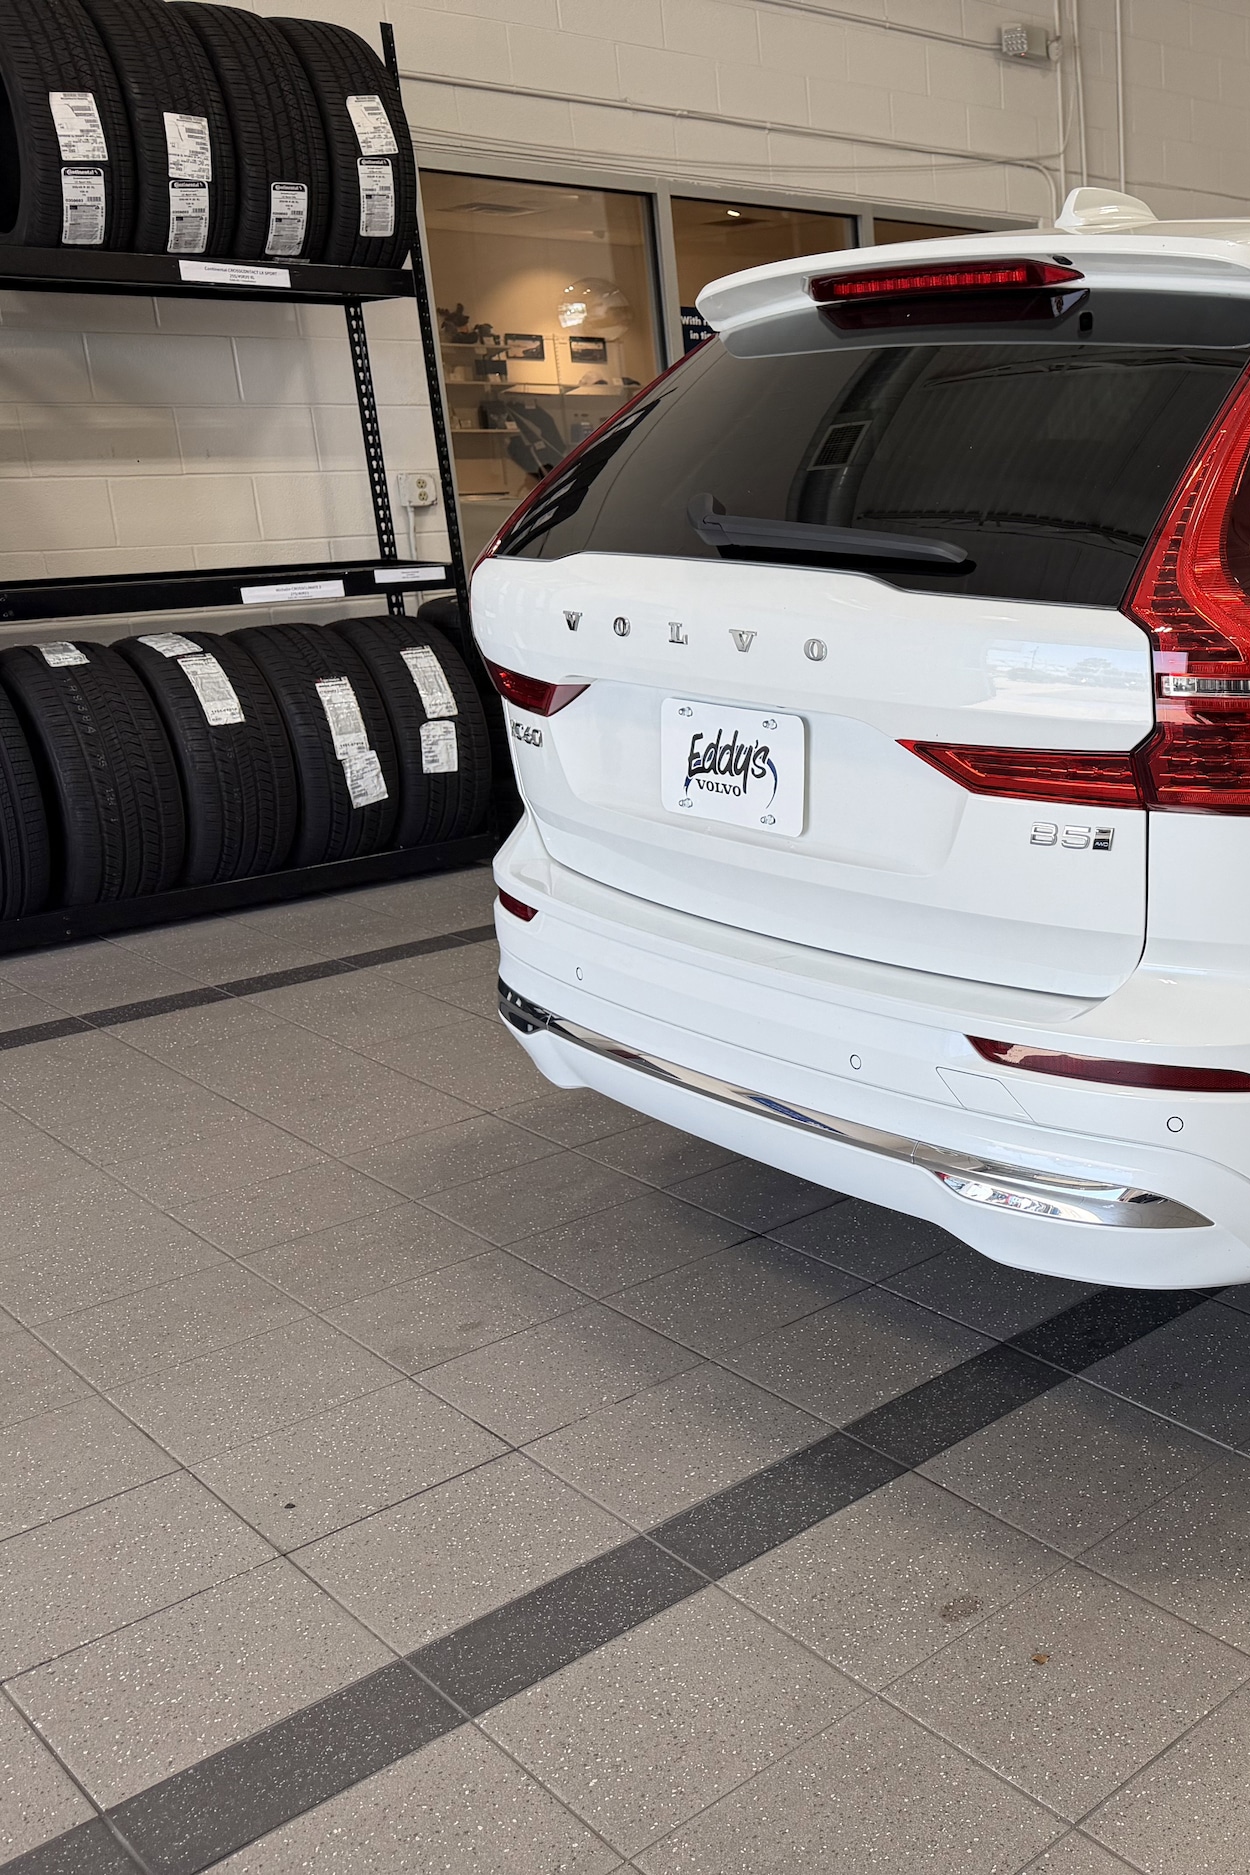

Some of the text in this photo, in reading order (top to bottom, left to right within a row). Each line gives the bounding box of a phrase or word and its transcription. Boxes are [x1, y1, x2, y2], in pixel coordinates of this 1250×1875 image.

[681, 315, 702, 326] With
[690, 330, 699, 340] in
[563, 610, 828, 662] VOLVO
[688, 728, 770, 794] Eddy's
[695, 778, 742, 797] VOLVO
[1030, 821, 1091, 850] B5
